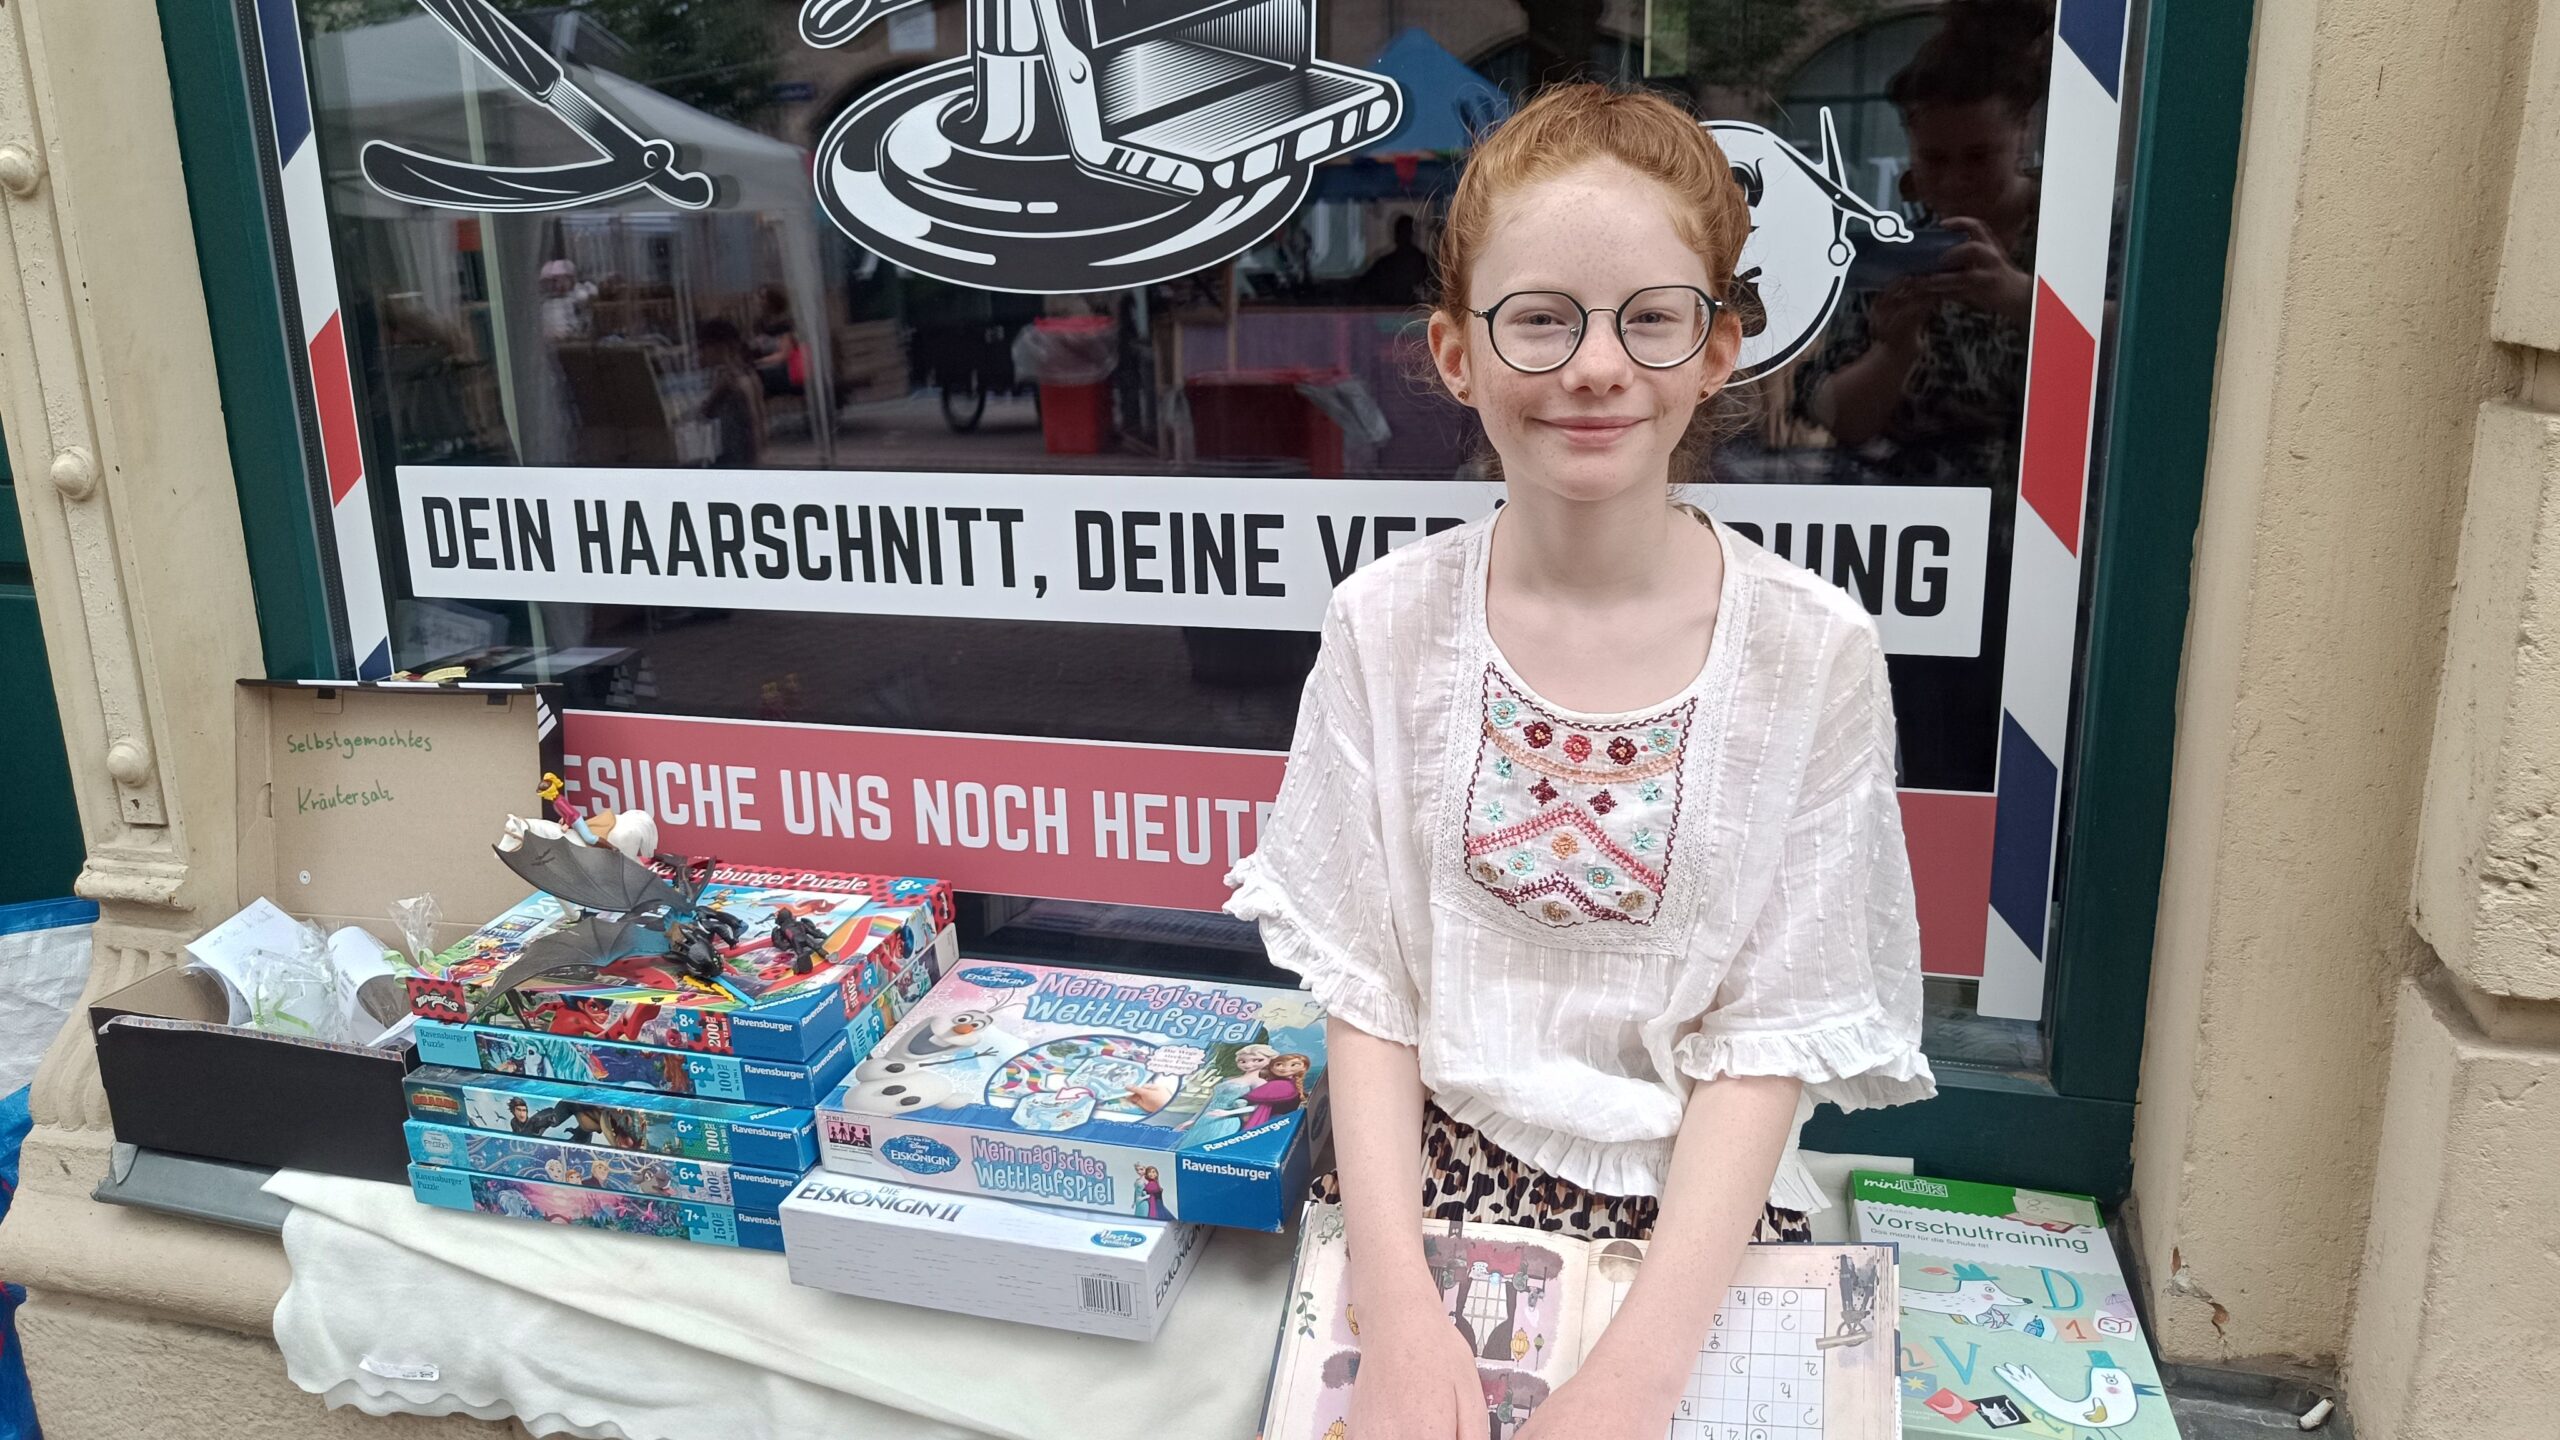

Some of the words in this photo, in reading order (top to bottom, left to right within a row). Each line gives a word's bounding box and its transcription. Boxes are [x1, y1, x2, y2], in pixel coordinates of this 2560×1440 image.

[422, 496, 555, 572] DEIN
[574, 499, 1048, 599] HAARSCHNITT,
[1075, 509, 1286, 598] DEINE
[287, 730, 432, 759] Selbstgemachtes
[298, 779, 394, 815] Kräutersalz
[563, 754, 762, 832] ESUCHE
[779, 769, 892, 842] UNS
[913, 778, 1069, 855] NOCH
[648, 860, 796, 887] Ransburger
[795, 873, 868, 892] Puzzle
[895, 879, 923, 891] 8+
[965, 973, 1027, 986] EISKÖNIGIN
[1040, 972, 1111, 999] Mein
[1115, 984, 1262, 1020] magisches
[801, 989, 839, 1027] Ravensburger
[679, 1013, 694, 1027] 8+
[732, 1016, 793, 1032] Ravensburger
[420, 1029, 468, 1042] Ravensburger
[422, 1038, 445, 1049] Puzzle
[706, 1024, 721, 1048] 200
[812, 1037, 847, 1075] Ravensburger
[690, 1061, 705, 1074] 6+
[744, 1064, 804, 1080] Ravensburger
[717, 1071, 732, 1093] 100
[677, 1120, 693, 1133] 6+
[731, 1123, 792, 1140] Ravensburger
[1203, 1117, 1290, 1152] Ravensburger
[705, 1130, 720, 1152] 100
[891, 1149, 950, 1166] EISKÖNIGIN
[971, 1136, 1015, 1163] Mein
[1018, 1145, 1105, 1180] magisches
[415, 1171, 463, 1185] Ravensburger
[679, 1167, 695, 1180] 6+
[733, 1171, 793, 1187] Ravensburger
[1182, 1158, 1271, 1181] Ravensburger
[417, 1181, 440, 1190] Puzzle
[707, 1177, 722, 1199] 100
[878, 1186, 903, 1196] DIE
[796, 1181, 940, 1217] EISKÖNIGIN
[937, 1203, 966, 1222] II
[684, 1209, 699, 1222] 7+
[738, 1213, 781, 1226] Ravensbu
[713, 1219, 727, 1240] 150
[1099, 1229, 1142, 1243] Hasbro
[1867, 1211, 2089, 1253] Vorschultraining
[1870, 1228, 1888, 1236] Das
[1889, 1231, 1916, 1240] macht
[1946, 1239, 1976, 1248] Schule
[2029, 1265, 2084, 1311] D
[1930, 1336, 1982, 1385] V
